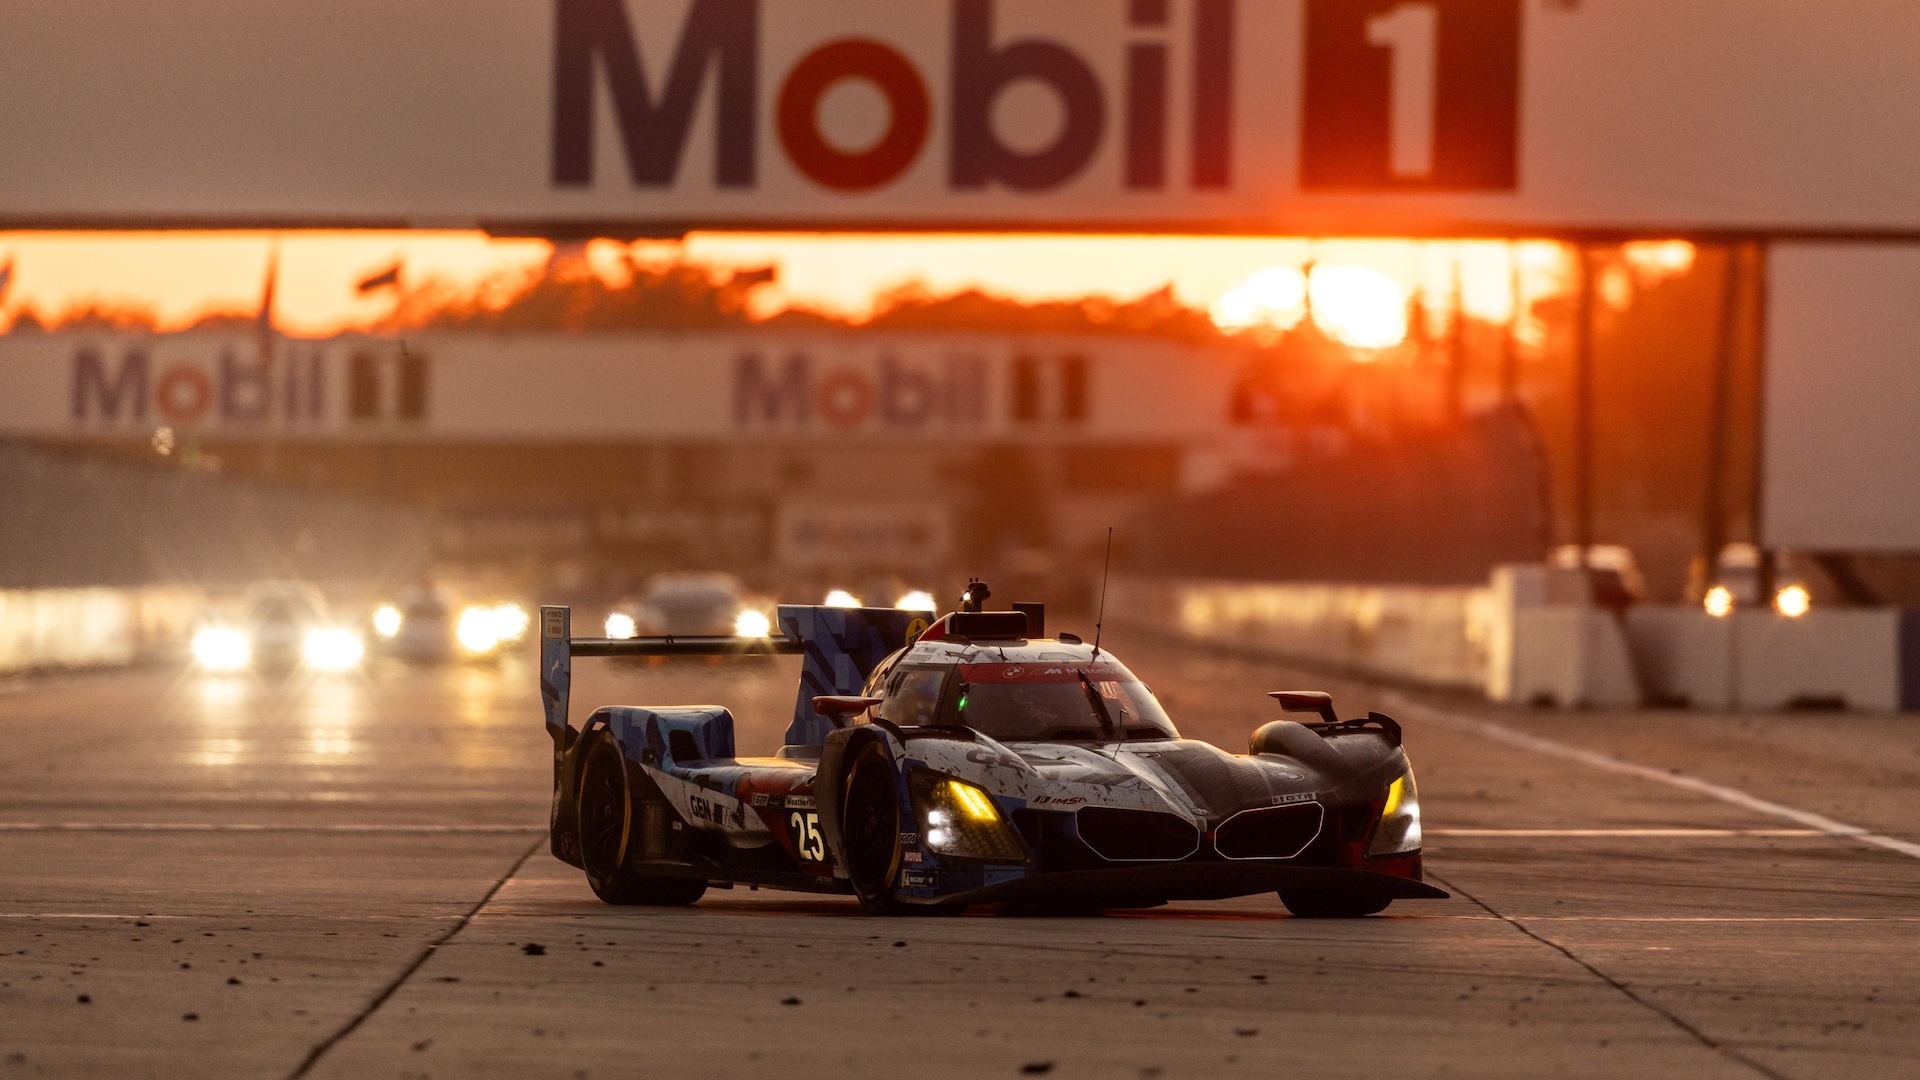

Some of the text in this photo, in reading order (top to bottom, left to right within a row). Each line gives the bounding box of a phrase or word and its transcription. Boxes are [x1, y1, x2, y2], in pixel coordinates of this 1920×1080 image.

[549, 0, 1435, 191] Mobil 1
[73, 350, 324, 422] Mobil
[734, 353, 988, 424] Mobil
[690, 795, 712, 822] GEN
[786, 797, 815, 806] WeatherTe
[1051, 796, 1088, 805] IMSA
[791, 811, 824, 862] 25
[904, 851, 922, 862] MOTUL
